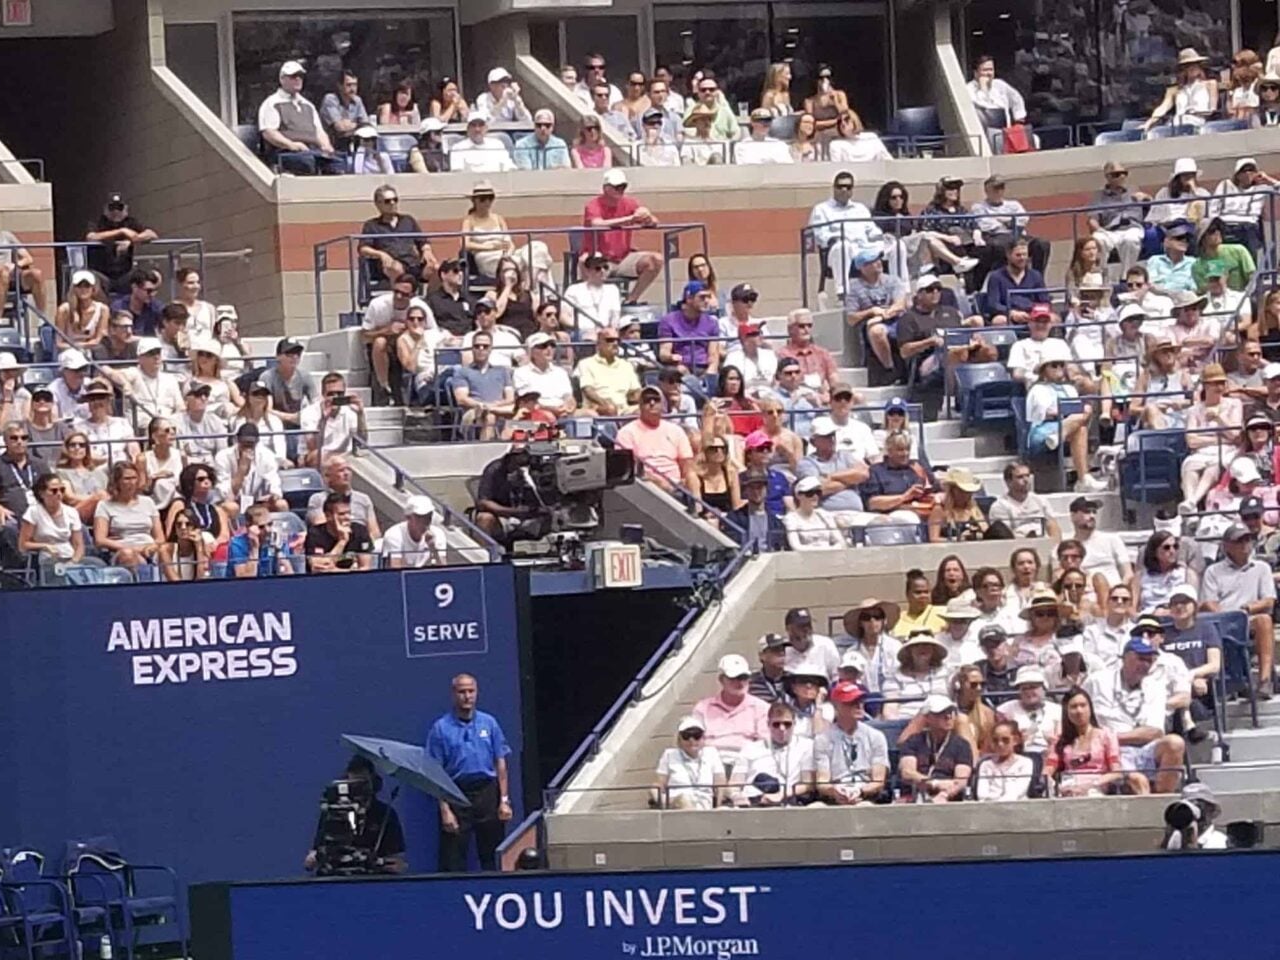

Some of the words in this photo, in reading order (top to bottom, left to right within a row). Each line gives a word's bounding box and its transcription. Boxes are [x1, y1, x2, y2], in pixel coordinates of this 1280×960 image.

[610, 552, 636, 582] EXIT
[434, 583, 454, 608] 9
[106, 612, 292, 652] AMERICAN
[414, 622, 480, 642] SERVE
[132, 646, 298, 686] EXPRESS
[464, 891, 563, 931] YOU
[622, 942, 636, 955] by
